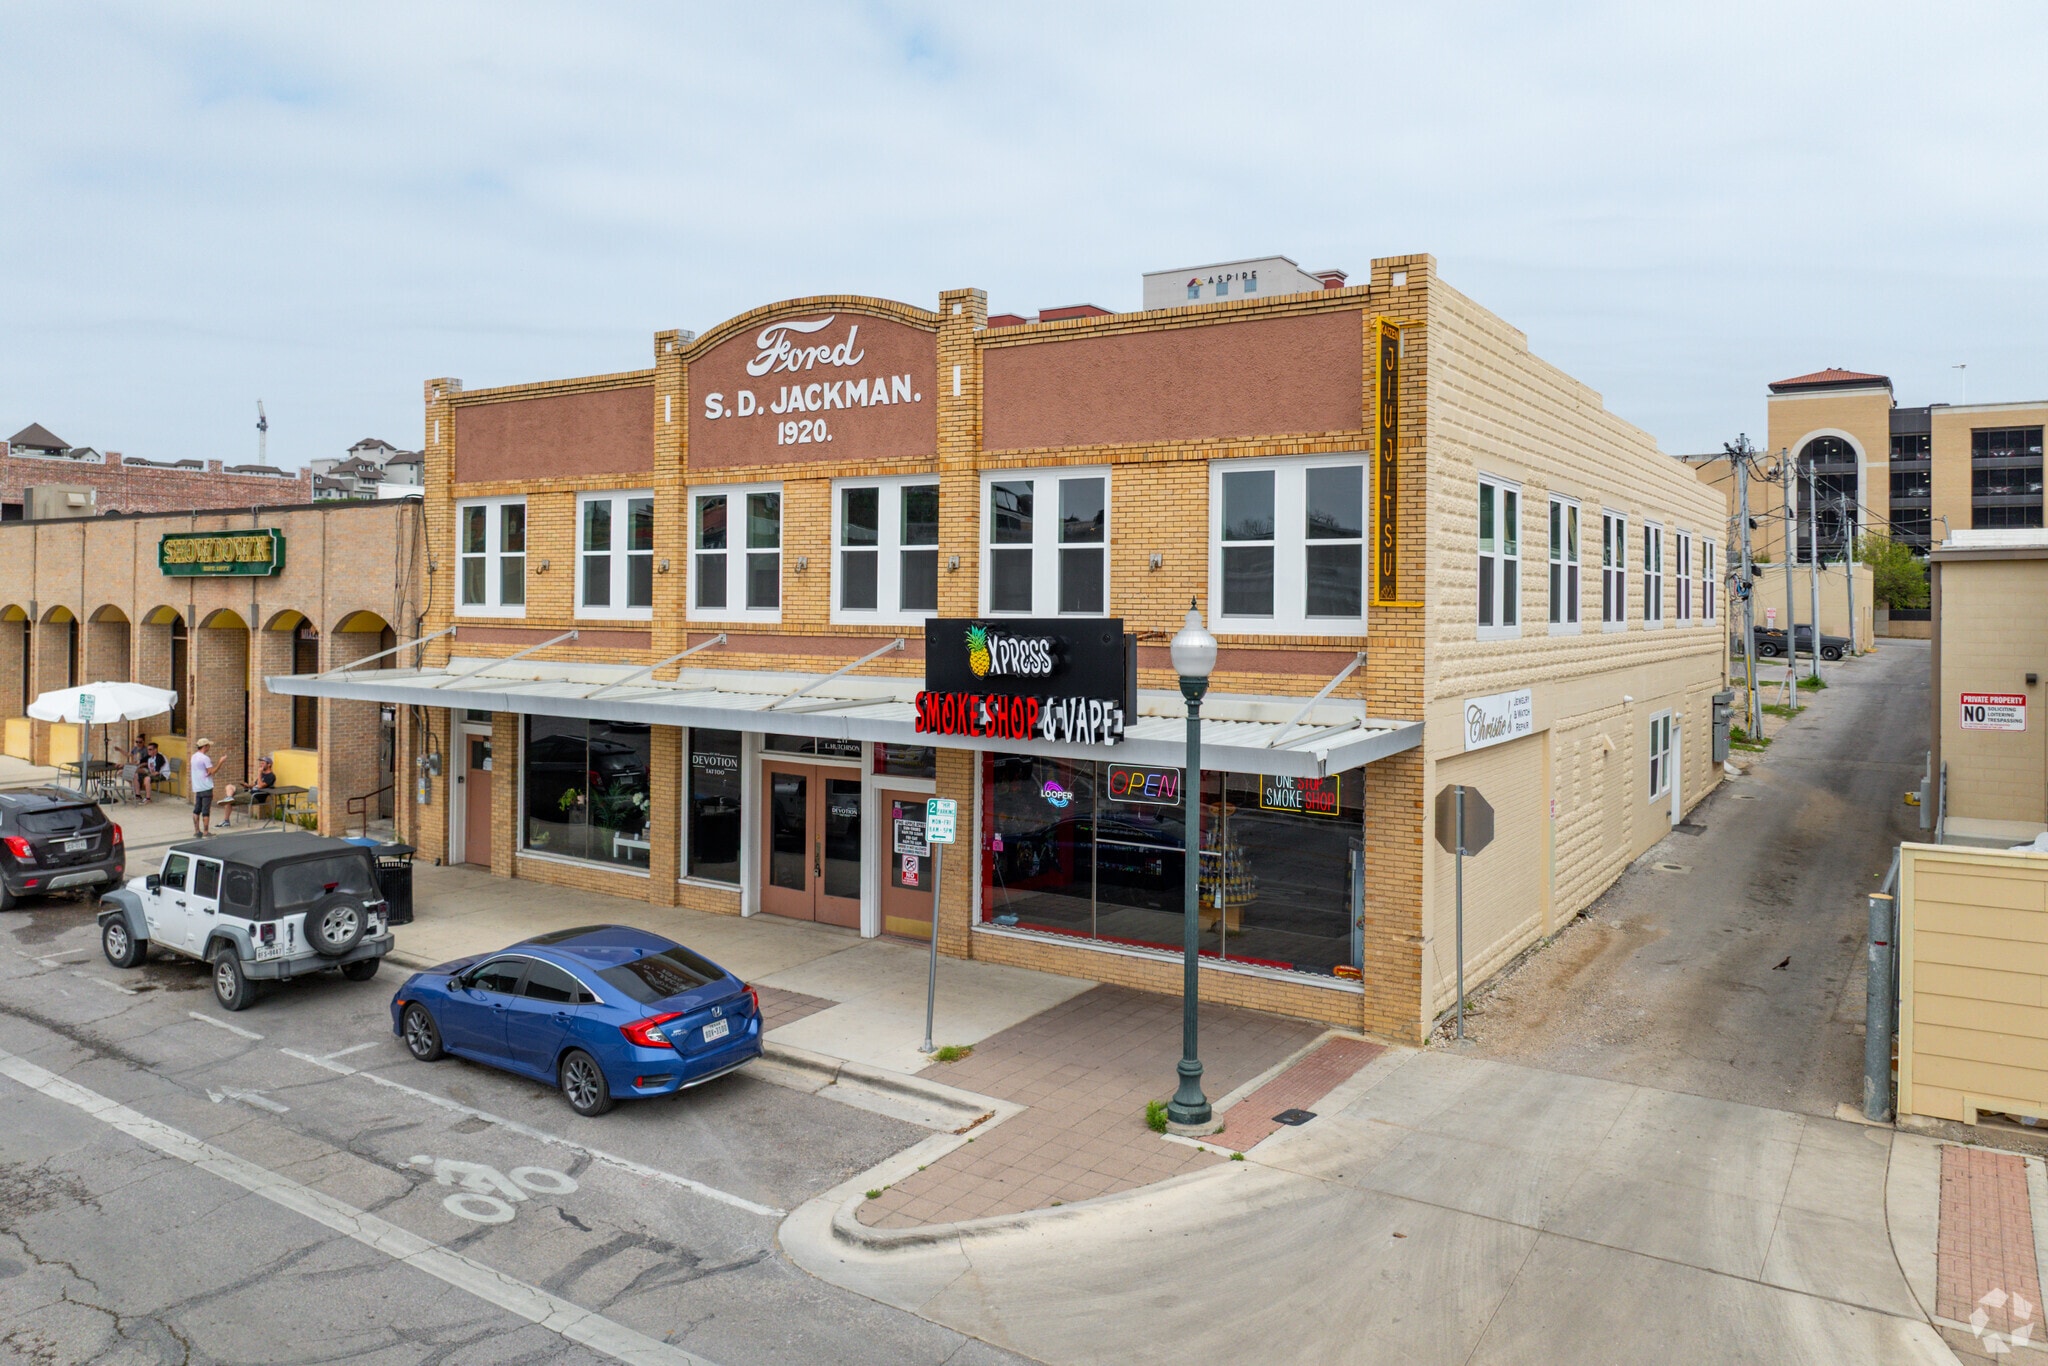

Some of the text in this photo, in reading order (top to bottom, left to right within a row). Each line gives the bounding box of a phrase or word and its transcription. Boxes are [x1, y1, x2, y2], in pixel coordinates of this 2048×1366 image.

[1208, 270, 1256, 284] ASPIRE
[746, 314, 865, 377] Ford
[704, 374, 921, 419] S. D. JACKMAN.
[778, 418, 833, 445] 1920.
[163, 536, 271, 563] SHOWDOWN
[987, 634, 1052, 675] XPRESS
[1963, 695, 2024, 704] PRIVATE PROPERTY
[915, 691, 1117, 746] SMOKE SHOP & VAPE
[1467, 700, 1511, 743] Christie's
[1964, 706, 1985, 722] NO
[692, 755, 737, 768] DEVOTION
[705, 768, 725, 776] TATTOO
[1275, 775, 1294, 789] ONE
[1110, 770, 1178, 798] OPEN
[1041, 789, 1073, 800] LOOPER
[1266, 787, 1335, 811] SMOKE SHOP
[831, 807, 858, 815] DEVOTION
[929, 801, 936, 813] 2
